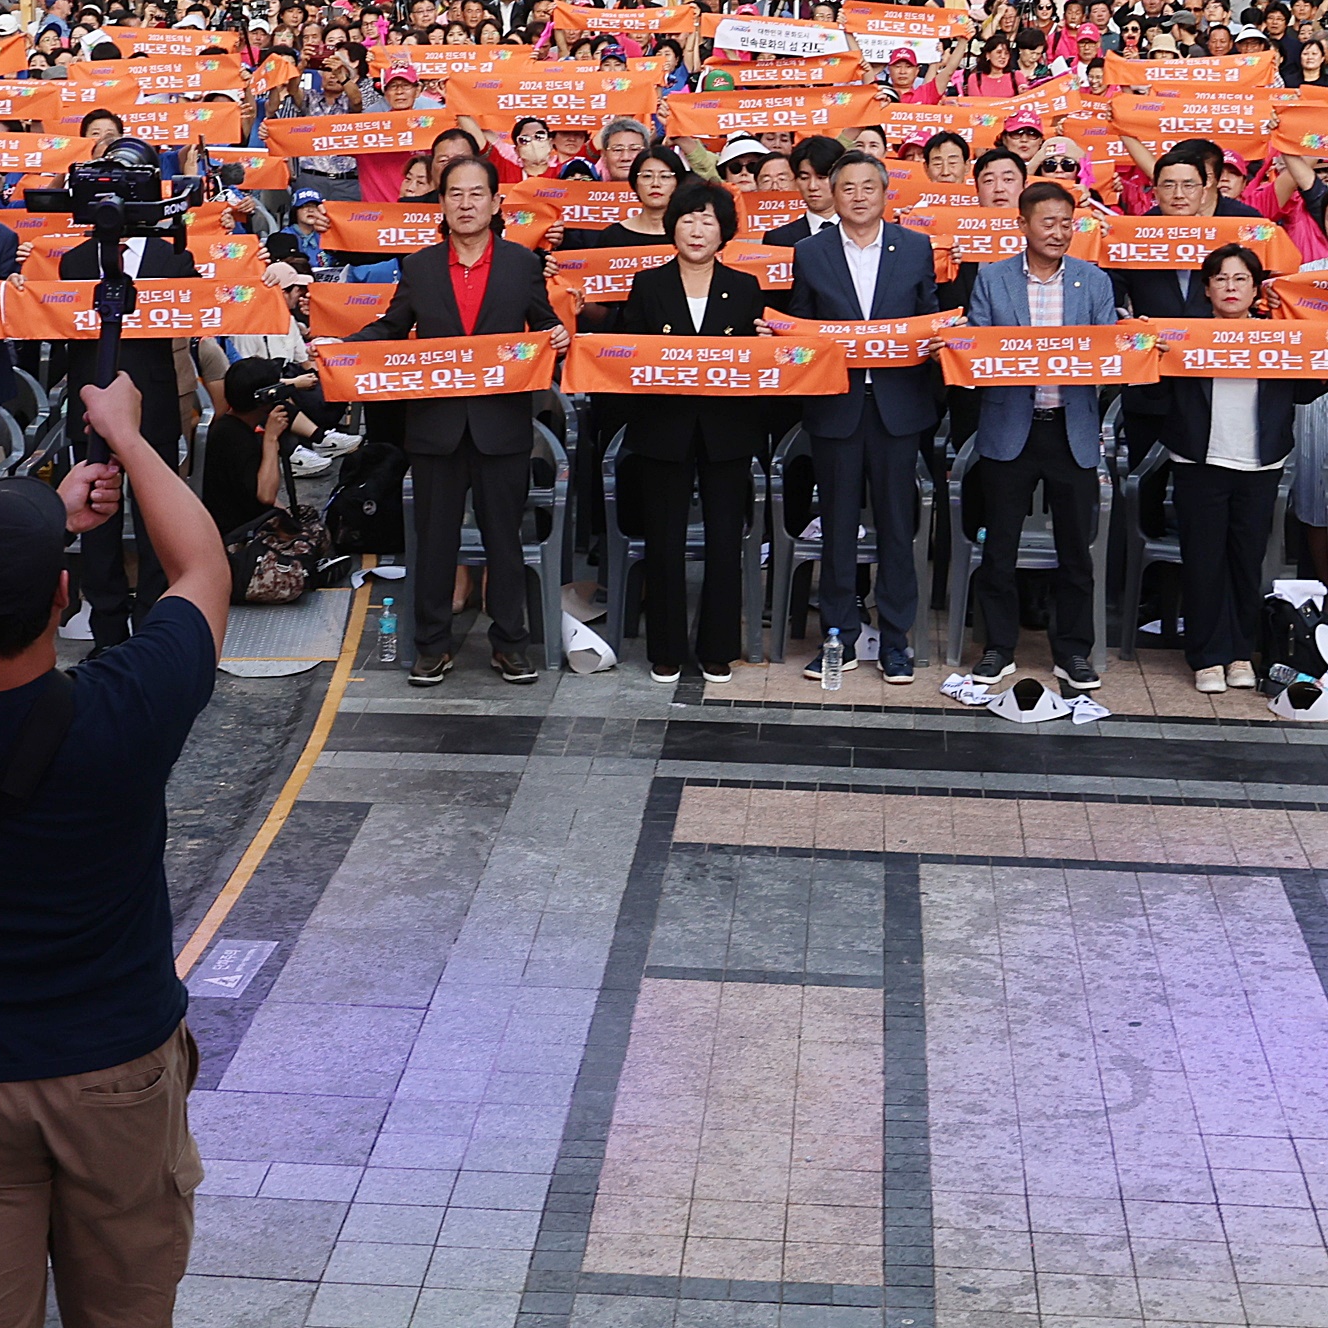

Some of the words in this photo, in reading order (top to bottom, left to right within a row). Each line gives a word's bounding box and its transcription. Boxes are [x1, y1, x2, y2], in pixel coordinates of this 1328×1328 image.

[741, 37, 786, 50] 민속문화의
[789, 42, 798, 52] 섬
[802, 42, 825, 54] 진도
[739, 99, 761, 109] 2024
[764, 98, 792, 108] 진도의
[795, 96, 805, 107] 날
[717, 112, 769, 129] 진도로
[773, 111, 807, 126] 오는
[811, 109, 828, 124] 길
[41, 291, 75, 303] Jindo
[138, 290, 172, 303] 진도의
[178, 289, 191, 302] 날
[73, 308, 145, 331] 진로
[149, 309, 194, 329] 오는
[200, 307, 222, 327] 길
[1212, 331, 1244, 344] 2024
[1247, 331, 1286, 344] 진도의
[1290, 331, 1302, 344] 날
[384, 353, 415, 365] 2024
[419, 351, 457, 364] 진도의
[460, 349, 473, 362] 날
[661, 348, 692, 360] 2024
[696, 348, 735, 362] 진도의
[740, 349, 751, 362] 날
[1183, 349, 1250, 370] 진도로
[1257, 349, 1302, 370] 오는
[354, 371, 424, 394] 진도로
[430, 369, 477, 390] 오는
[483, 366, 505, 387] 길
[630, 367, 700, 387] 진도로
[706, 368, 751, 388] 오는
[757, 368, 780, 389] 길
